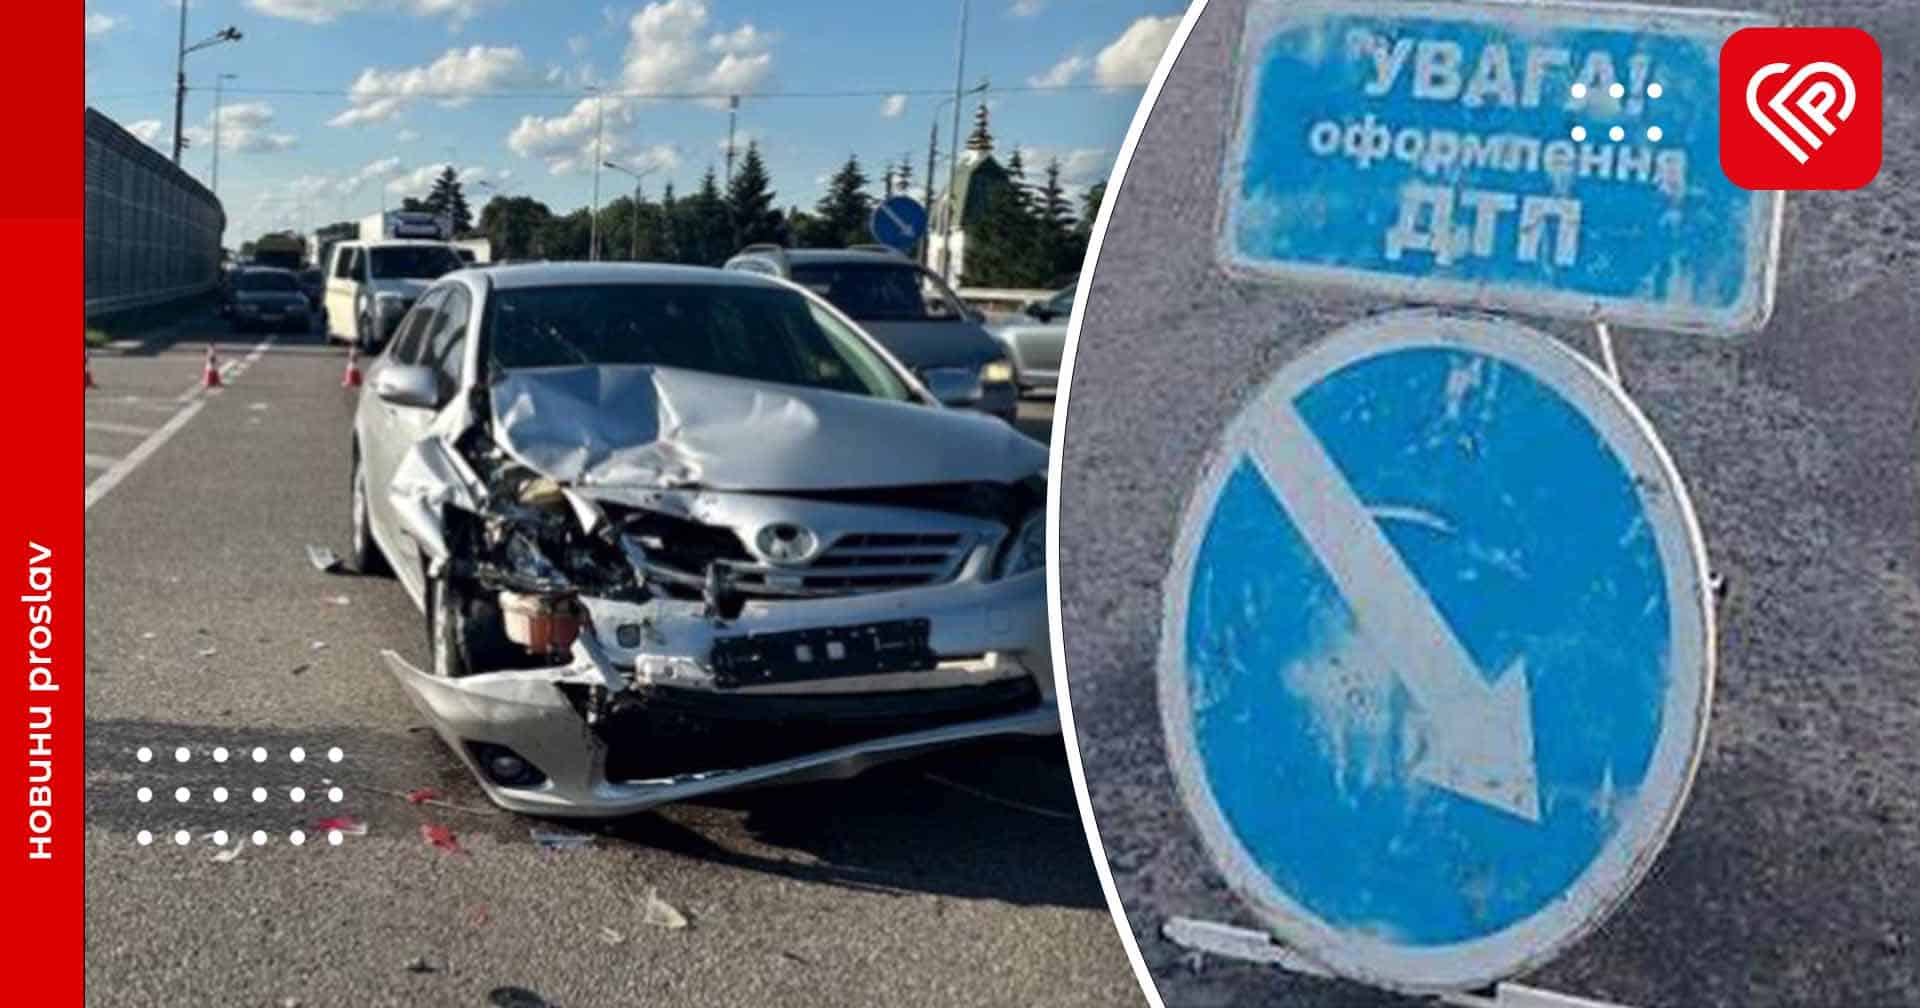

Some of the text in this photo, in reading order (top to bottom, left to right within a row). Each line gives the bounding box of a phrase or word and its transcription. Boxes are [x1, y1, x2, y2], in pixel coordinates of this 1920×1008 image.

[1350, 36, 1650, 117] УВАГА!
[1308, 113, 1688, 198] оформлення
[1384, 183, 1582, 267] ДТП
